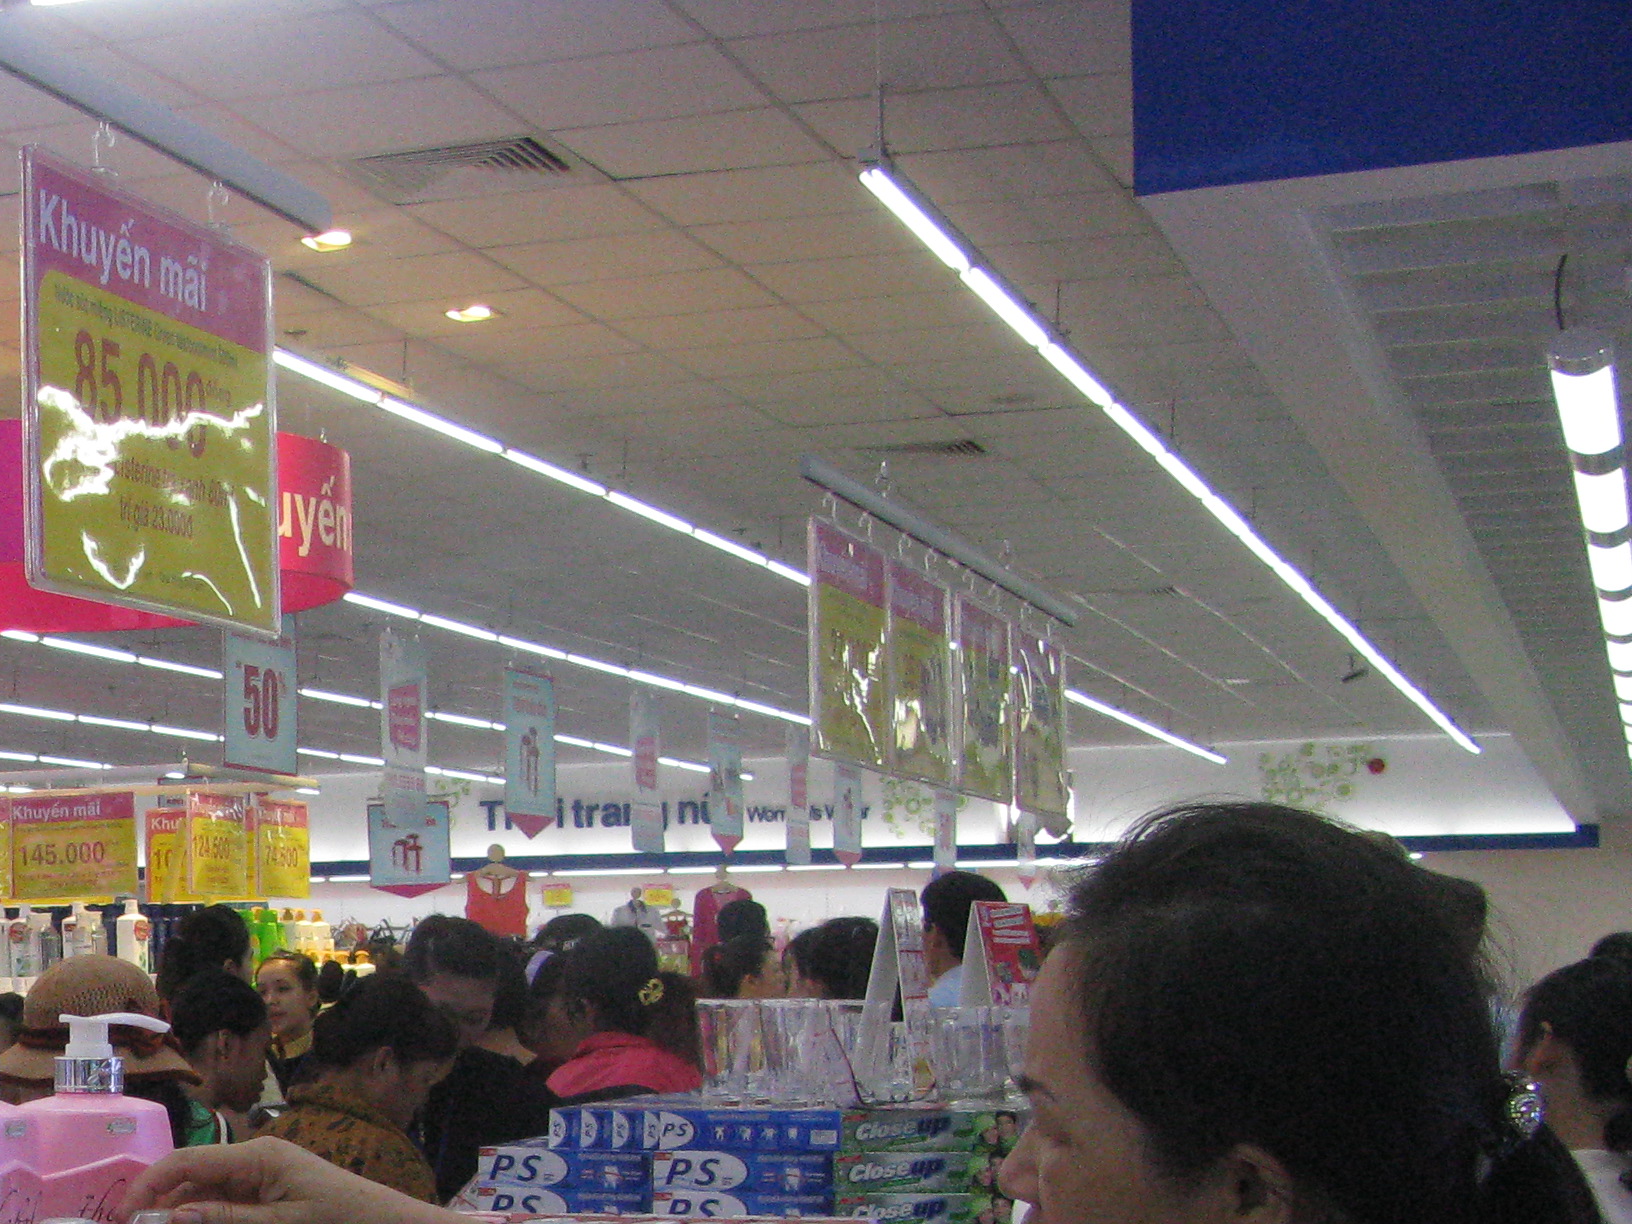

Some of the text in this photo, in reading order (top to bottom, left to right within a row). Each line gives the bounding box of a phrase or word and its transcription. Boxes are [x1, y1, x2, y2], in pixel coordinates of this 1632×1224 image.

[38, 188, 208, 313] Khuyến mãi
[12, 799, 102, 822] Khuyến mãi
[19, 841, 105, 867] 145.000
[662, 1122, 689, 1138] PS
[488, 1153, 543, 1183] PS
[665, 1156, 721, 1187] PS
